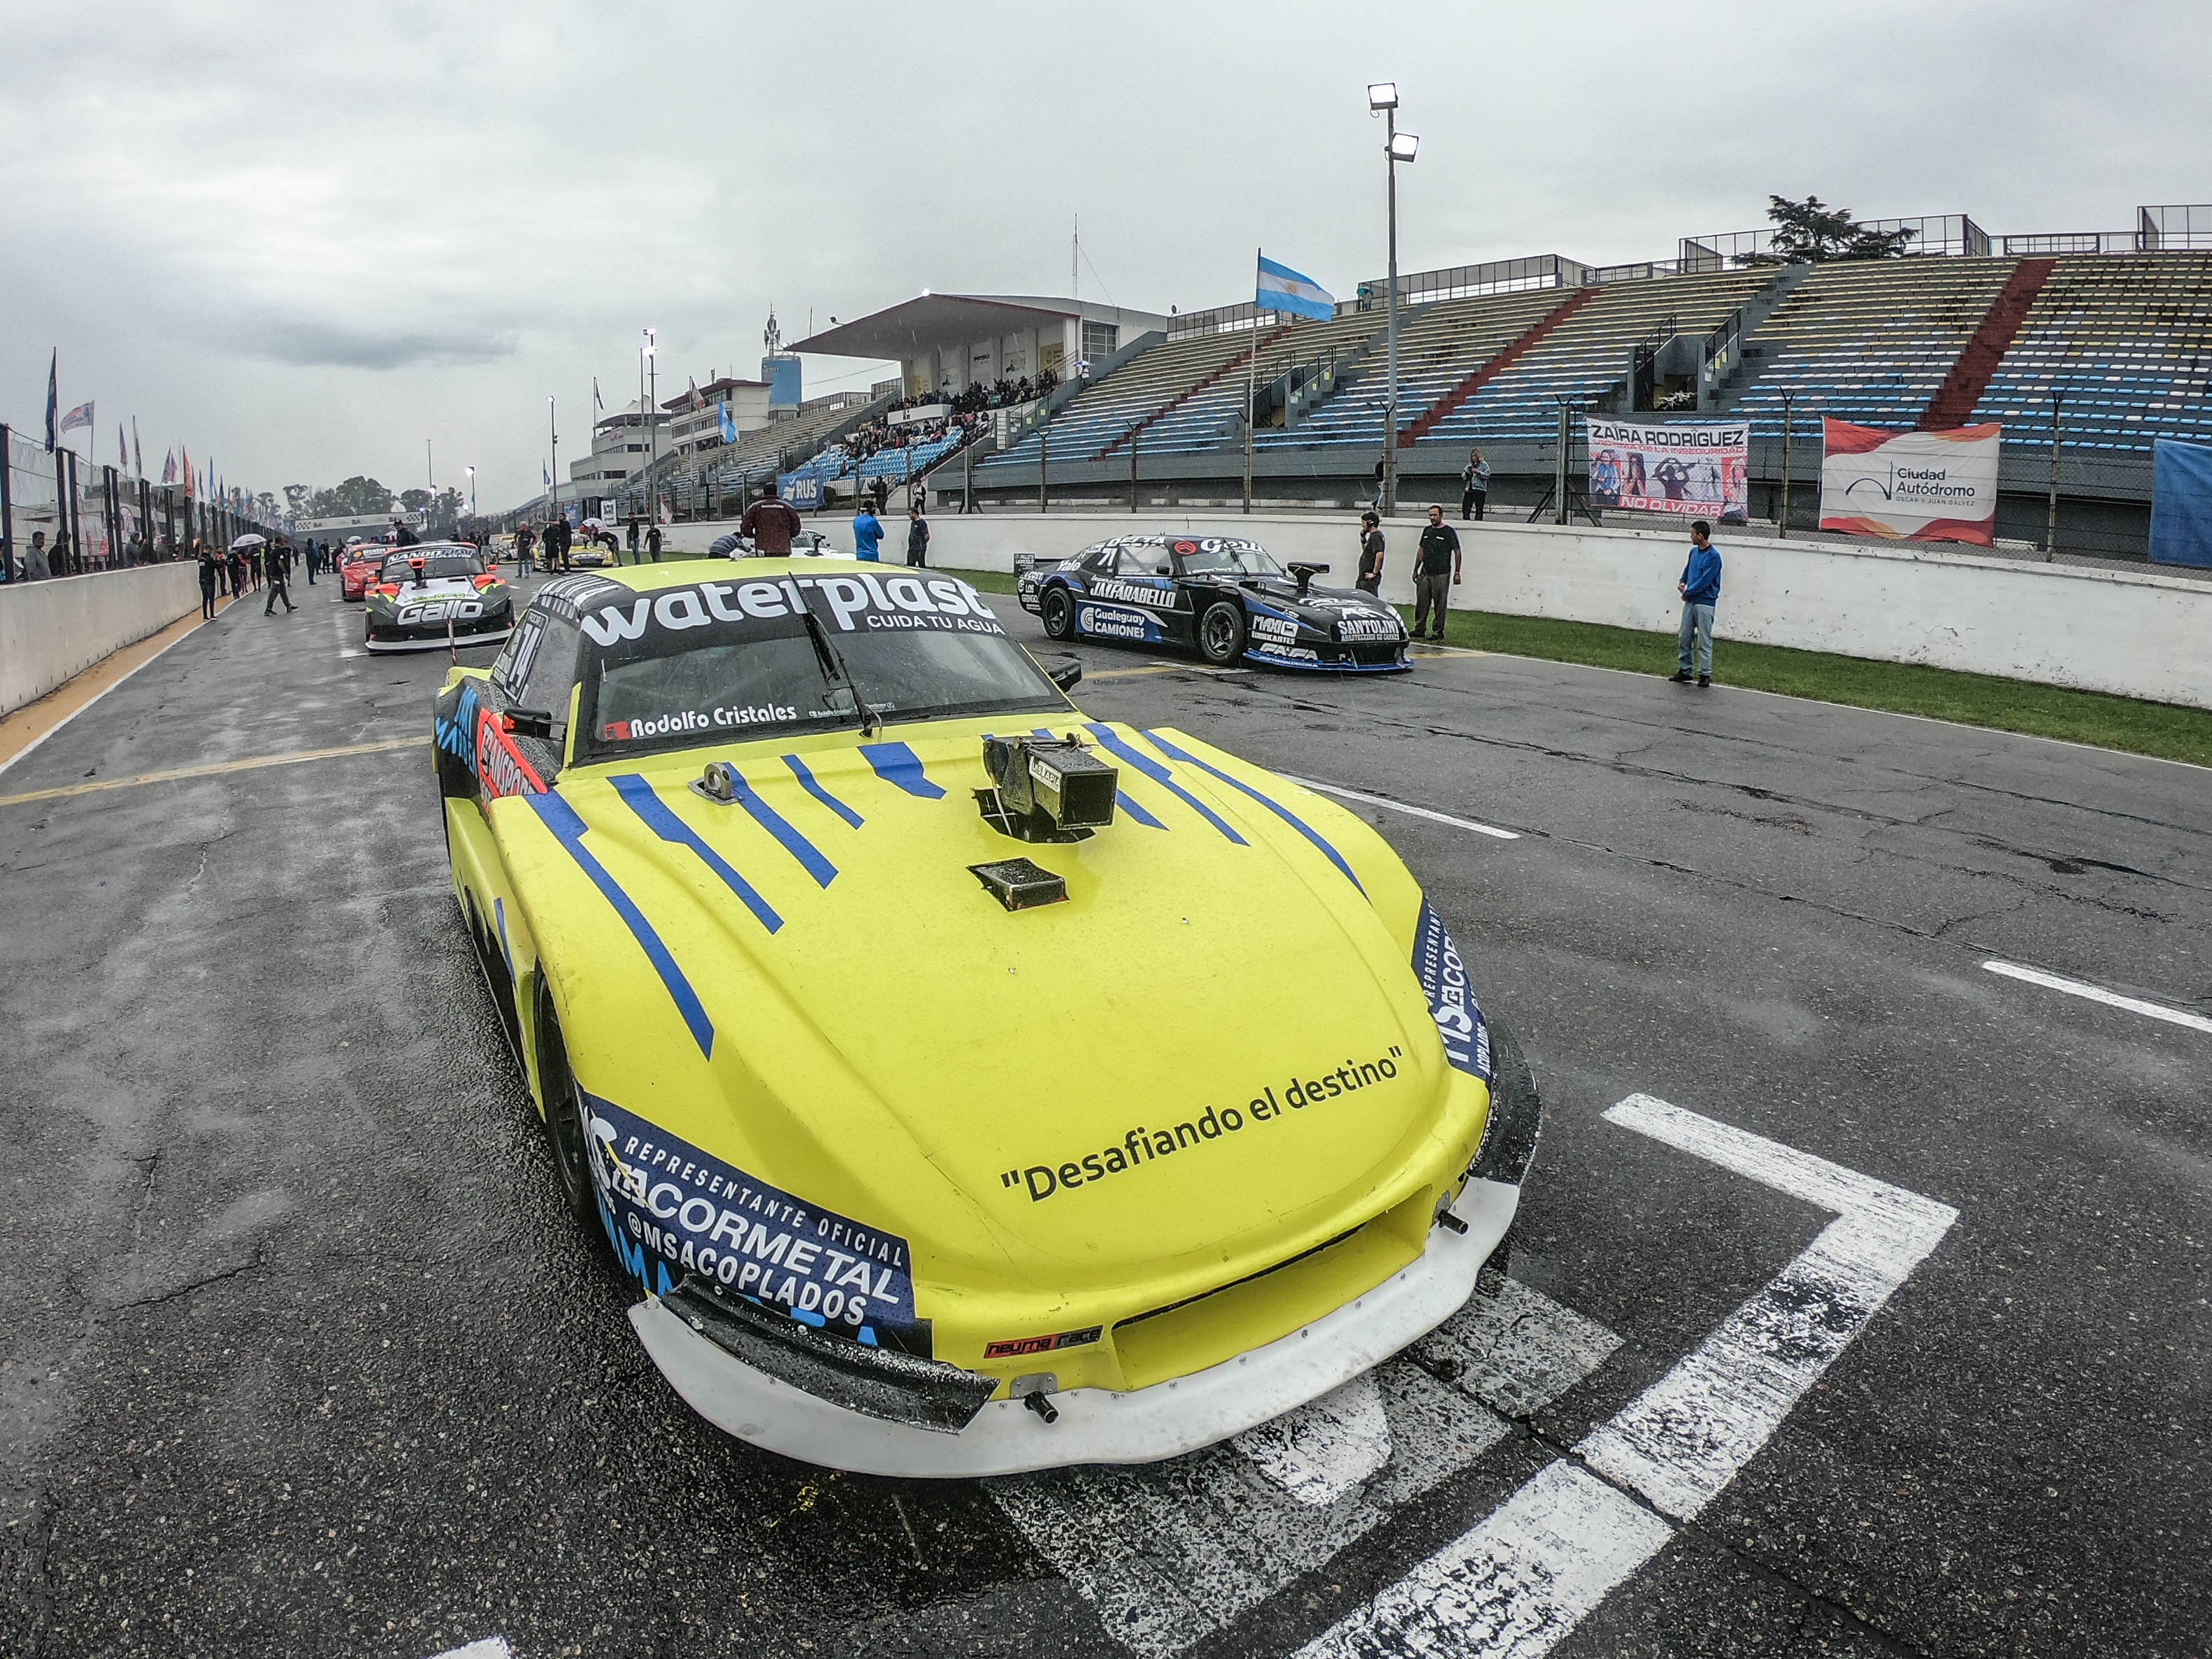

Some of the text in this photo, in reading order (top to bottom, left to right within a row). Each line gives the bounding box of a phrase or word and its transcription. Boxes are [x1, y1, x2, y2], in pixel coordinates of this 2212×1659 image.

[1897, 468, 1946, 481] Ciudad
[796, 479, 817, 499] RUS
[1896, 481, 1975, 497] Autódromo
[1621, 496, 1723, 517] NO OLVIDAR
[1056, 559, 1082, 572] Yale
[1097, 547, 1118, 566] 71
[397, 600, 484, 625] Gallo
[580, 573, 997, 646] waterplast
[1095, 608, 1145, 626] Gualeguay
[866, 615, 1007, 635] CUIDA TU AGUA
[1094, 622, 1145, 639] CAMIONES
[1337, 620, 1400, 635] SANTOLINI
[631, 712, 710, 738] Rodolfo
[713, 703, 798, 725] Cristales
[1000, 1045, 1403, 1203] "Desafiando el destino"
[624, 1136, 807, 1228] REPRESENTANTE
[817, 1218, 903, 1267] OFICIAL
[628, 1211, 868, 1326] @MSACOPLADOS
[1056, 1329, 1100, 1346] race
